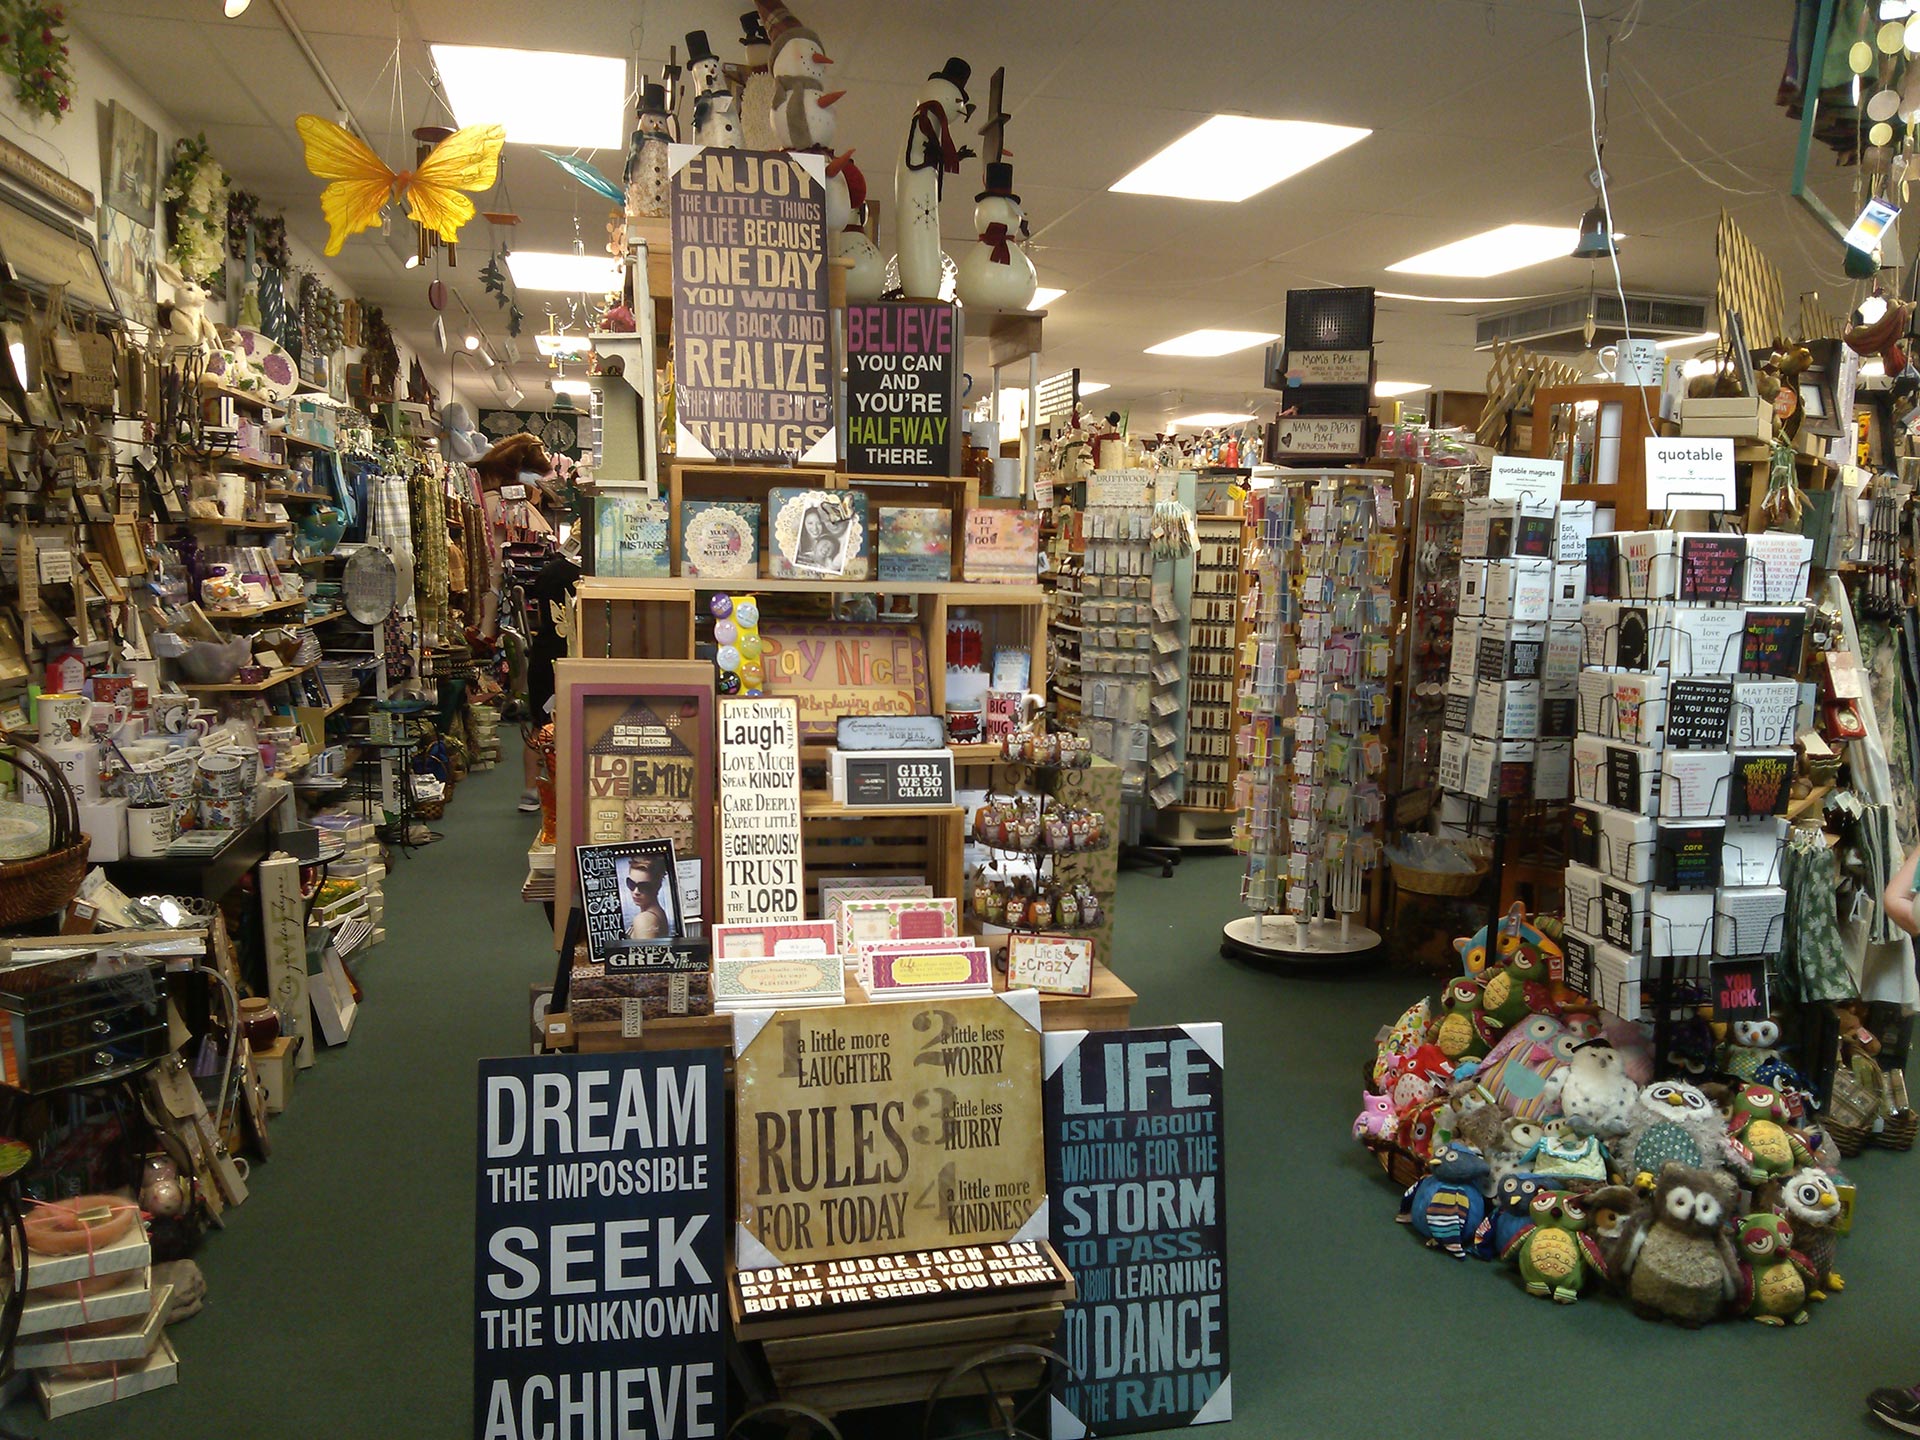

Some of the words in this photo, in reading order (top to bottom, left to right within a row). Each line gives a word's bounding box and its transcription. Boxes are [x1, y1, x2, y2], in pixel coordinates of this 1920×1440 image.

[681, 155, 814, 199] ENJOY
[679, 194, 700, 212] THE
[705, 196, 772, 217] LITTLE
[779, 199, 821, 221] THINGS
[681, 216, 700, 241] IN
[704, 218, 738, 244] LIFE
[744, 219, 821, 250] BECAUSE
[682, 246, 750, 285] ONE
[758, 249, 822, 290] DAY
[683, 287, 733, 307] YOU
[740, 290, 826, 312] WILL
[683, 310, 729, 336] LOOK
[739, 312, 779, 339] BACK
[788, 316, 825, 342] AND
[848, 307, 951, 352] BELIEVE
[685, 339, 826, 392] REALIZE
[857, 355, 896, 371] YOU
[902, 356, 942, 371] CAN
[880, 374, 919, 390] AND
[713, 391, 744, 420] WERE
[746, 393, 764, 420] THE
[770, 394, 827, 422] BIG
[856, 393, 942, 413] YOU'RE
[686, 421, 828, 451] THINGS
[850, 416, 947, 445] HALFWAY
[866, 448, 933, 465] THERE.
[1658, 448, 1723, 463] quotable
[1499, 467, 1527, 475] quotable
[1529, 469, 1555, 477] magnets
[624, 514, 650, 523] There
[974, 516, 994, 525] LET
[620, 541, 664, 550] MISTAKES
[625, 533, 639, 541] NO
[975, 536, 989, 544] GO
[1577, 541, 1585, 549] be
[1700, 614, 1726, 622] dance
[1703, 628, 1720, 636] love
[1701, 643, 1719, 652] sing
[1701, 657, 1716, 665] live
[990, 701, 1006, 713] BIG
[615, 726, 625, 734] In
[724, 720, 784, 750] Laugh
[988, 721, 1008, 734] HUG
[1670, 728, 1692, 736] NOT
[1696, 730, 1722, 738] FAIL?
[1740, 727, 1791, 742] SIDE
[750, 772, 794, 789] KINDLY
[897, 765, 942, 777] GIRL
[897, 778, 921, 787] WE
[923, 777, 942, 787] SO
[898, 787, 943, 797] CRAZY!
[734, 834, 799, 856] GENEROUSLY
[583, 857, 615, 876] QUEEN
[726, 859, 798, 885] TRUST
[600, 877, 617, 889] JUST
[727, 903, 744, 912] THE
[747, 888, 798, 913] LORD
[730, 890, 740, 899] IN
[590, 913, 621, 932] EVERY
[609, 952, 692, 966] GREAT
[629, 946, 672, 954] EXPECT
[1724, 973, 1752, 988] YOU
[1721, 988, 1761, 1009] ROCK.
[811, 1029, 846, 1051] little
[850, 1031, 890, 1049] more
[951, 1026, 979, 1044] little
[981, 1024, 1005, 1042] less
[798, 1051, 893, 1089] LAUGHTER
[941, 1044, 1005, 1078] WORRY
[1062, 1039, 1212, 1115] LIFE
[486, 1064, 708, 1159] DREAM
[952, 1102, 978, 1118] little
[981, 1098, 1003, 1115] less
[944, 1116, 1002, 1151] HURRY
[1062, 1118, 1126, 1142] ISN'T
[1135, 1111, 1216, 1137] ABOUT
[755, 1101, 909, 1196] RULES
[1062, 1141, 1138, 1183] WAITING
[1146, 1139, 1180, 1177] FOR
[1185, 1135, 1218, 1174] THE
[486, 1165, 539, 1204] THE
[547, 1154, 709, 1200] IMPOSSIBLE
[958, 1180, 990, 1200] little
[995, 1178, 1030, 1195] more
[948, 1198, 1032, 1236] KINDNESS
[1063, 1176, 1216, 1237] STORM
[756, 1202, 814, 1253] FOR
[820, 1191, 909, 1246] TODAY
[487, 1214, 712, 1300] SEEK
[1063, 1240, 1097, 1267] TO
[1107, 1231, 1216, 1264] PASS...
[738, 1264, 817, 1285] DON'T
[829, 1254, 907, 1275] JUDGE
[918, 1246, 983, 1265] EACH
[992, 1241, 1040, 1259] DAY
[741, 1283, 775, 1298] BY
[780, 1278, 823, 1294] THE
[827, 1268, 933, 1288] HARVEST
[936, 1261, 986, 1281] YOU
[744, 1295, 789, 1313] BUT
[795, 1291, 825, 1308] BY
[830, 1288, 871, 1304] THE
[872, 1280, 939, 1300] SEEDS
[942, 1273, 990, 1294] YOU
[992, 1265, 1057, 1286] PLANT
[1084, 1267, 1111, 1302] ABOUT
[1115, 1258, 1221, 1299] LEARNING
[481, 1306, 543, 1350] THE
[553, 1293, 720, 1345] UNKNOWN
[1064, 1308, 1087, 1382] TO
[1095, 1294, 1220, 1379] DANCE
[483, 1362, 715, 1440] ACHIEVE
[1116, 1371, 1221, 1419] RAIN
